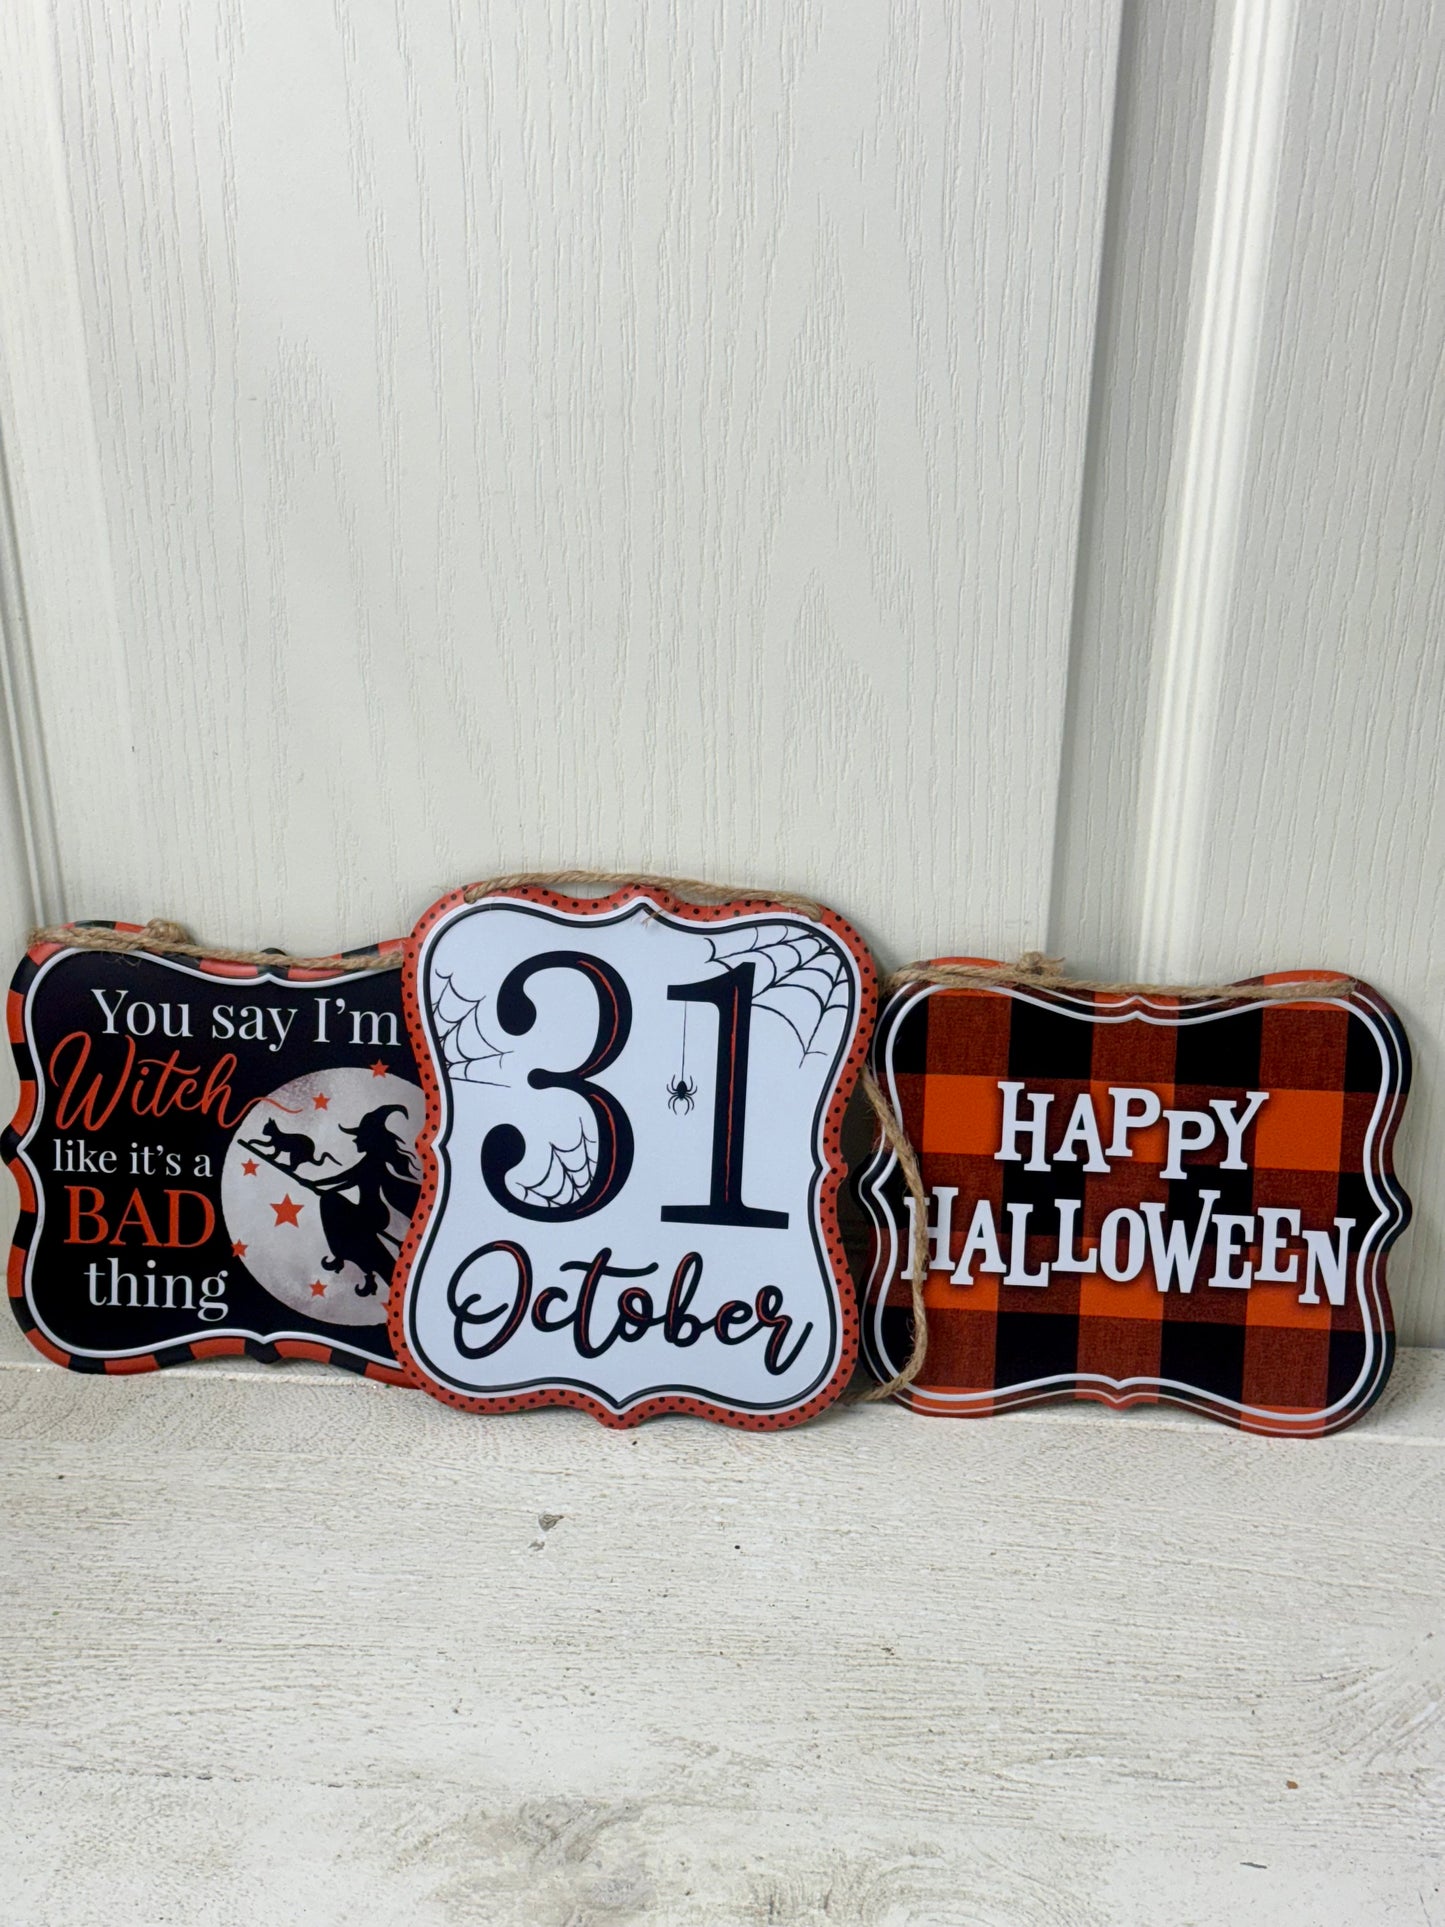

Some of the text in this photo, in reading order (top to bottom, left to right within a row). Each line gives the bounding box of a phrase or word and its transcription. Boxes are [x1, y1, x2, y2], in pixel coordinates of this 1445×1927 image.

[91, 988, 402, 1052] You say I'm
[49, 1031, 303, 1132] Witch
[480, 950, 790, 1229] 31
[994, 1081, 1270, 1180] HAPPY
[52, 1139, 118, 1174] like
[193, 1152, 213, 1178] a
[63, 1185, 216, 1248] BAD
[901, 1186, 1356, 1306] HALLOWEEN
[85, 1258, 229, 1322] thing
[446, 1239, 814, 1376] October
